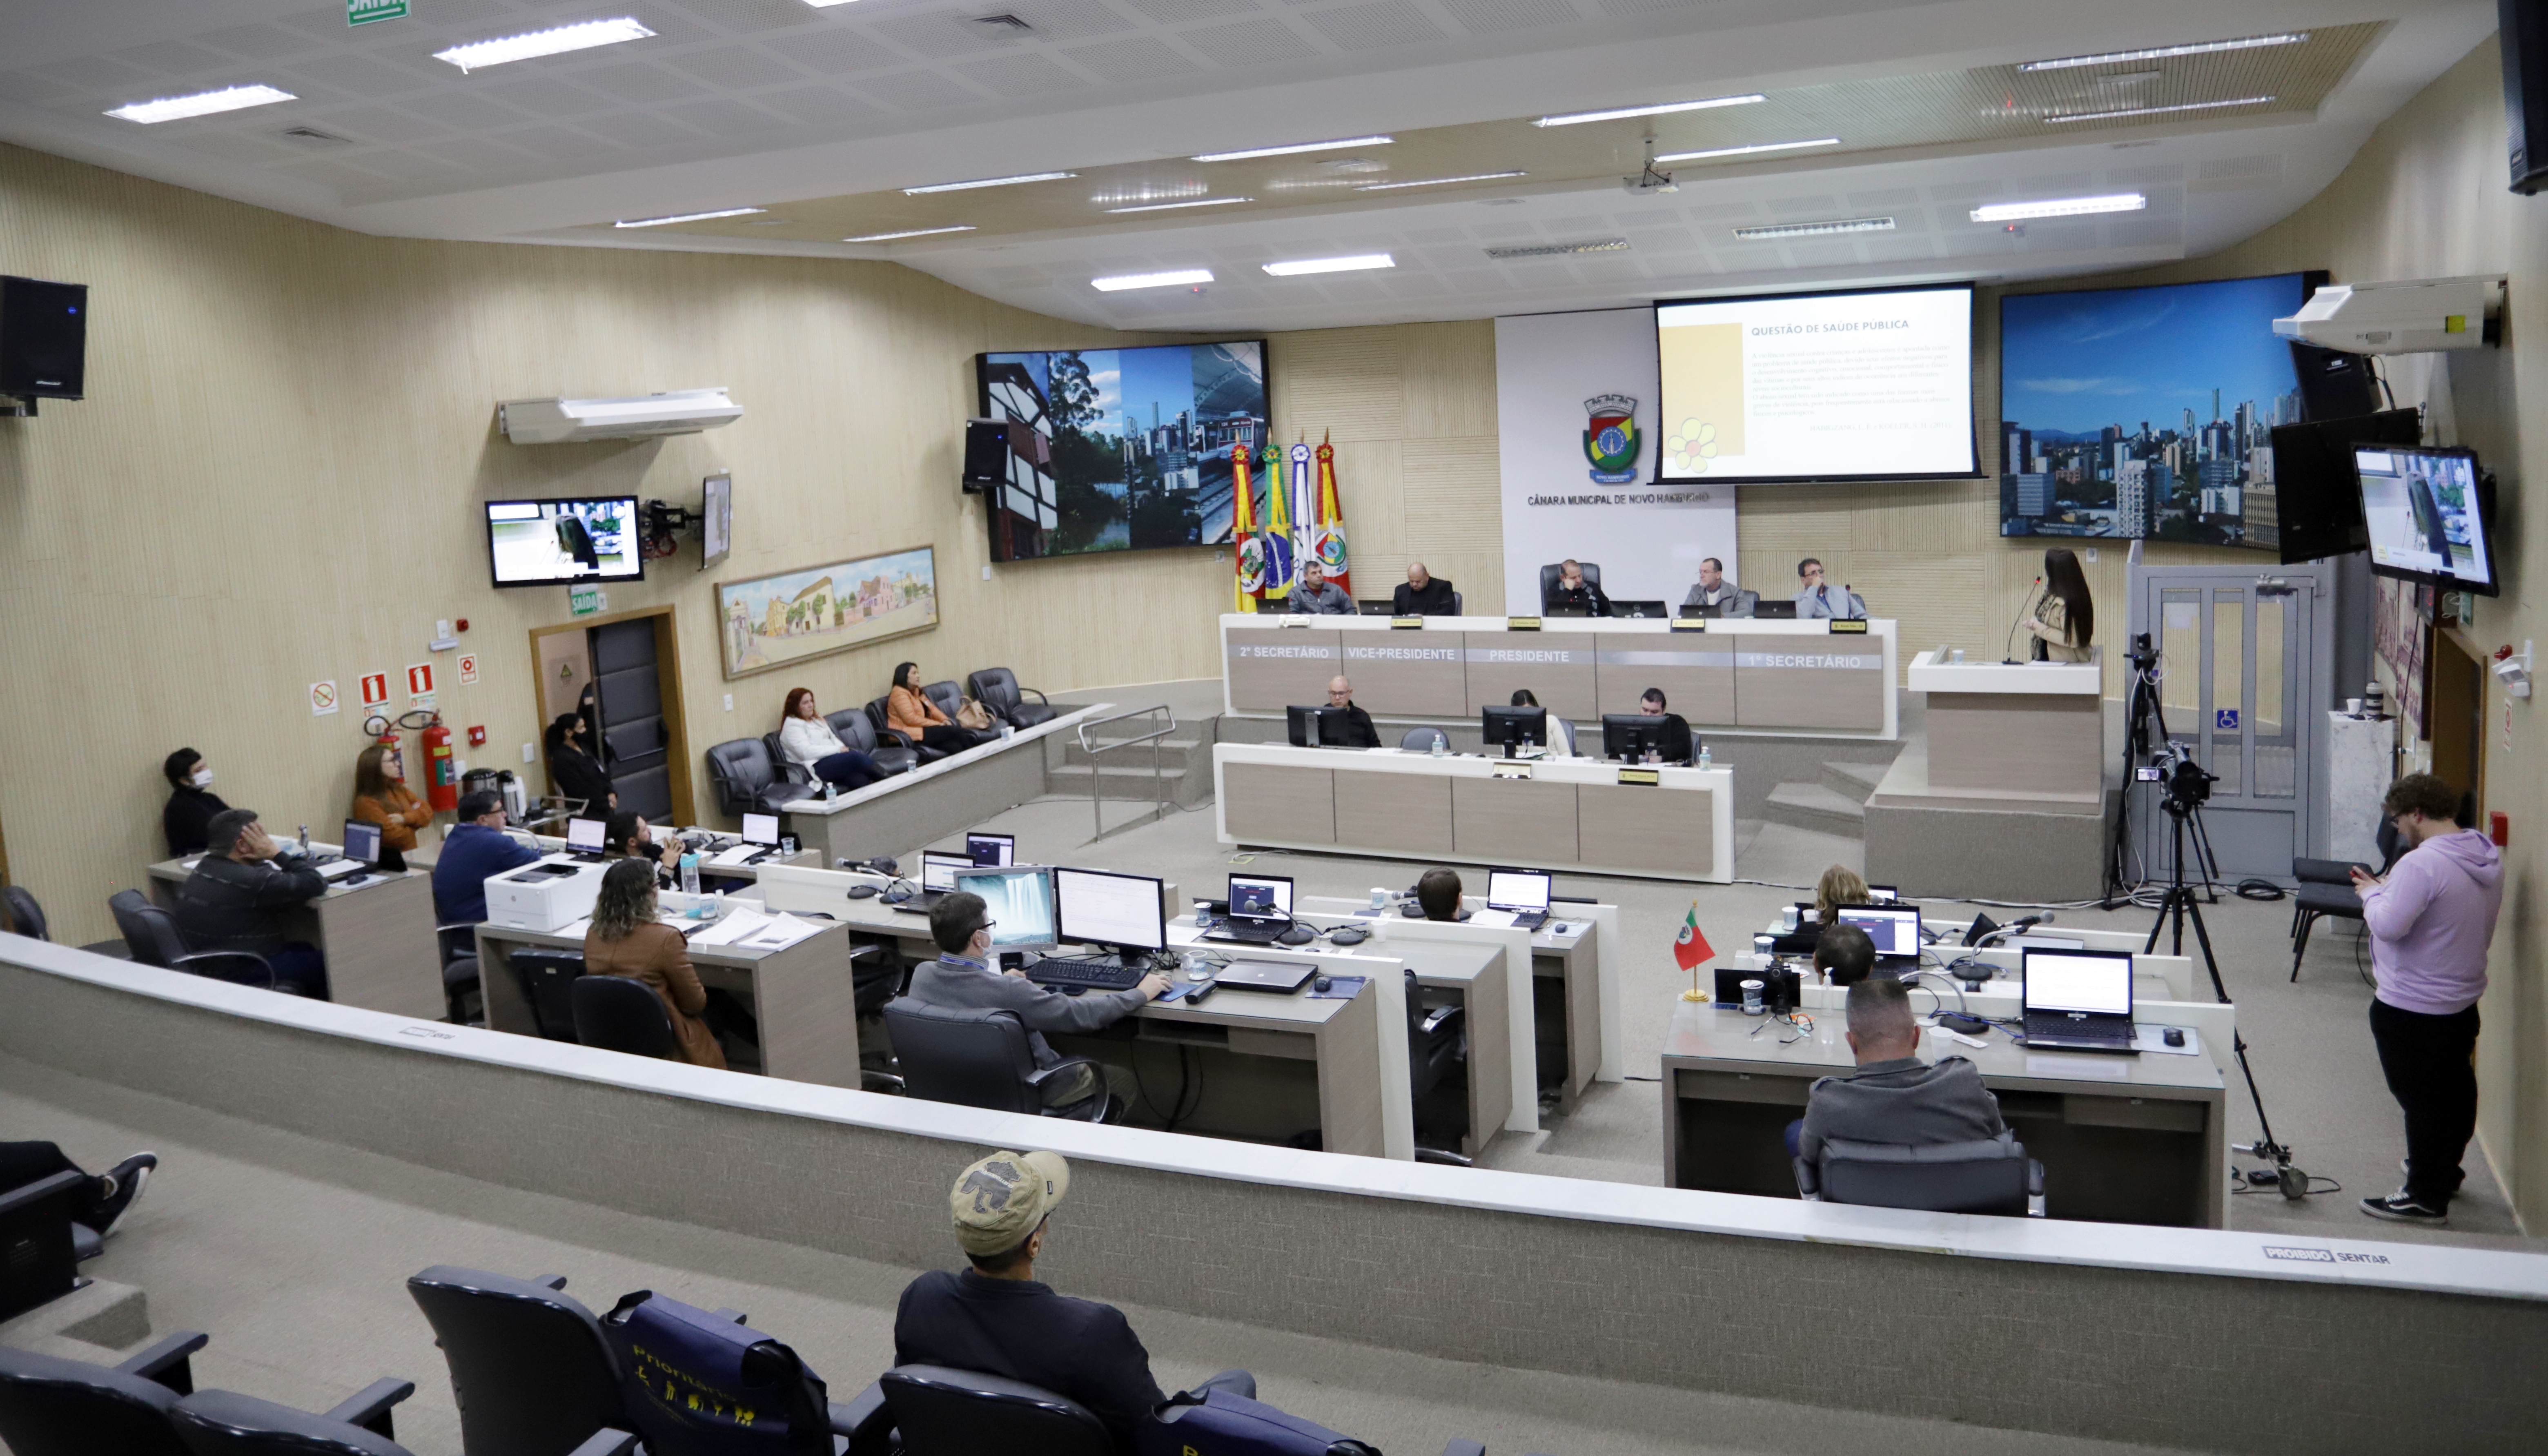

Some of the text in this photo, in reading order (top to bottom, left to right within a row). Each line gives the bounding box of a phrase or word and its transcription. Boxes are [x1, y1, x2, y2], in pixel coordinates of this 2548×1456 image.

[1752, 319, 1908, 336] QUESTÃO DE SAÚDE PÚBLICA
[1528, 494, 1566, 505] CÂMARA
[1568, 495, 1612, 505] MUNICIPAL
[1614, 494, 1626, 504] DE
[1629, 494, 1655, 504] NOVO
[572, 593, 597, 611] SAÍDA
[1254, 646, 1329, 658] SECRETÁRIO
[1348, 647, 1455, 660] VICE-PRESIDENTE
[1490, 650, 1569, 662] PRESIDENTE
[1766, 654, 1861, 668] SECRETÁRIO
[2266, 1248, 2391, 1265] PROIBIDO SENTAR
